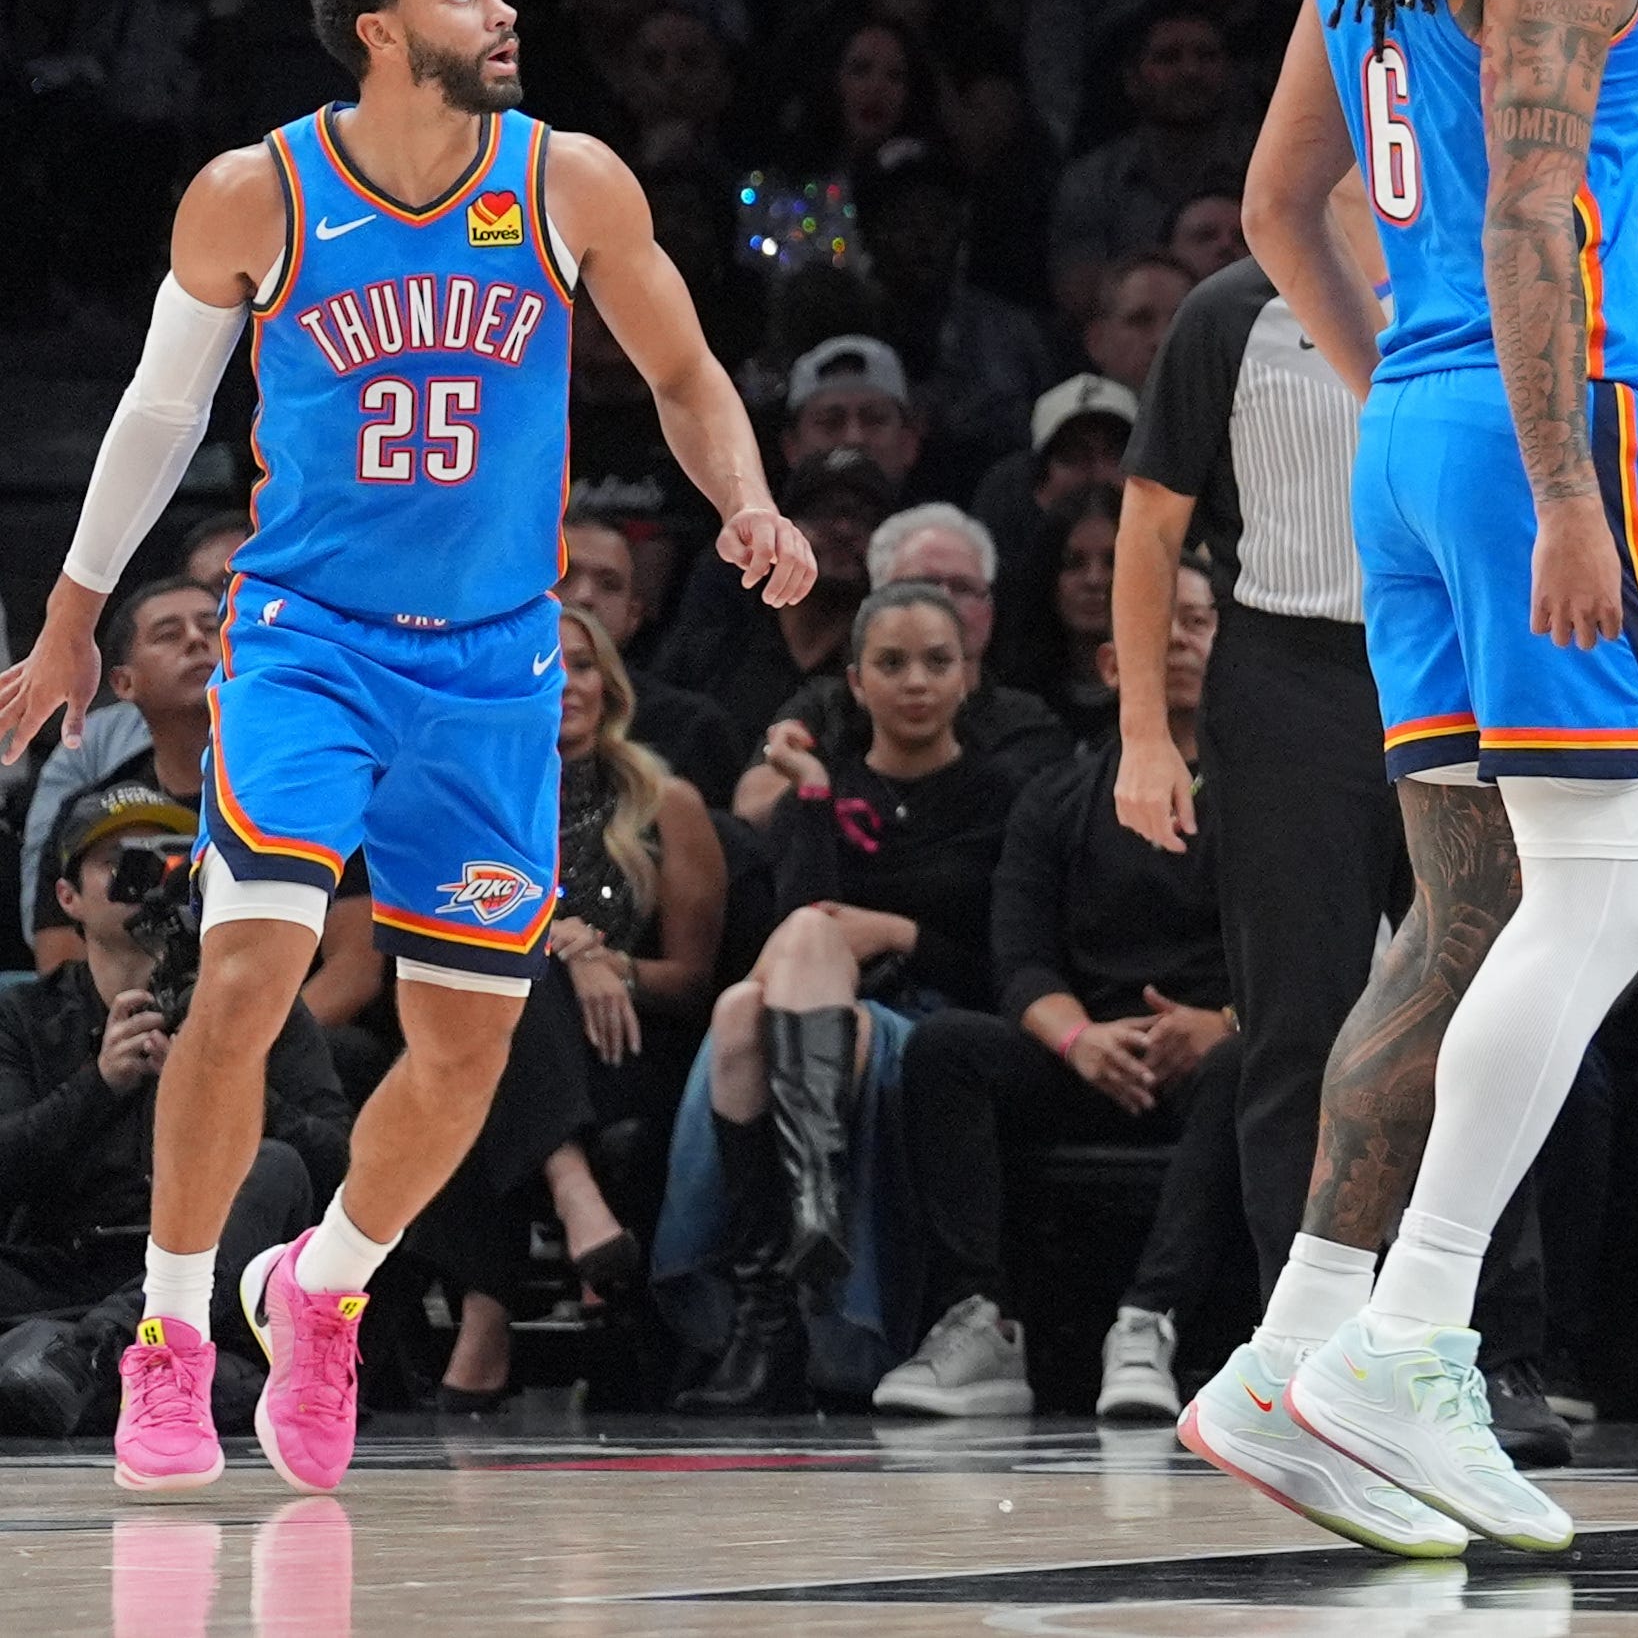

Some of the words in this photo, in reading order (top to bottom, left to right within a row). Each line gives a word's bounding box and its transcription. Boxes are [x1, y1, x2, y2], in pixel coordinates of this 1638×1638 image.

[1360, 39, 1421, 228] 6
[472, 224, 520, 242] Love's
[297, 274, 545, 376] THUNDER
[357, 376, 481, 485] 25
[455, 879, 516, 903] OKC
